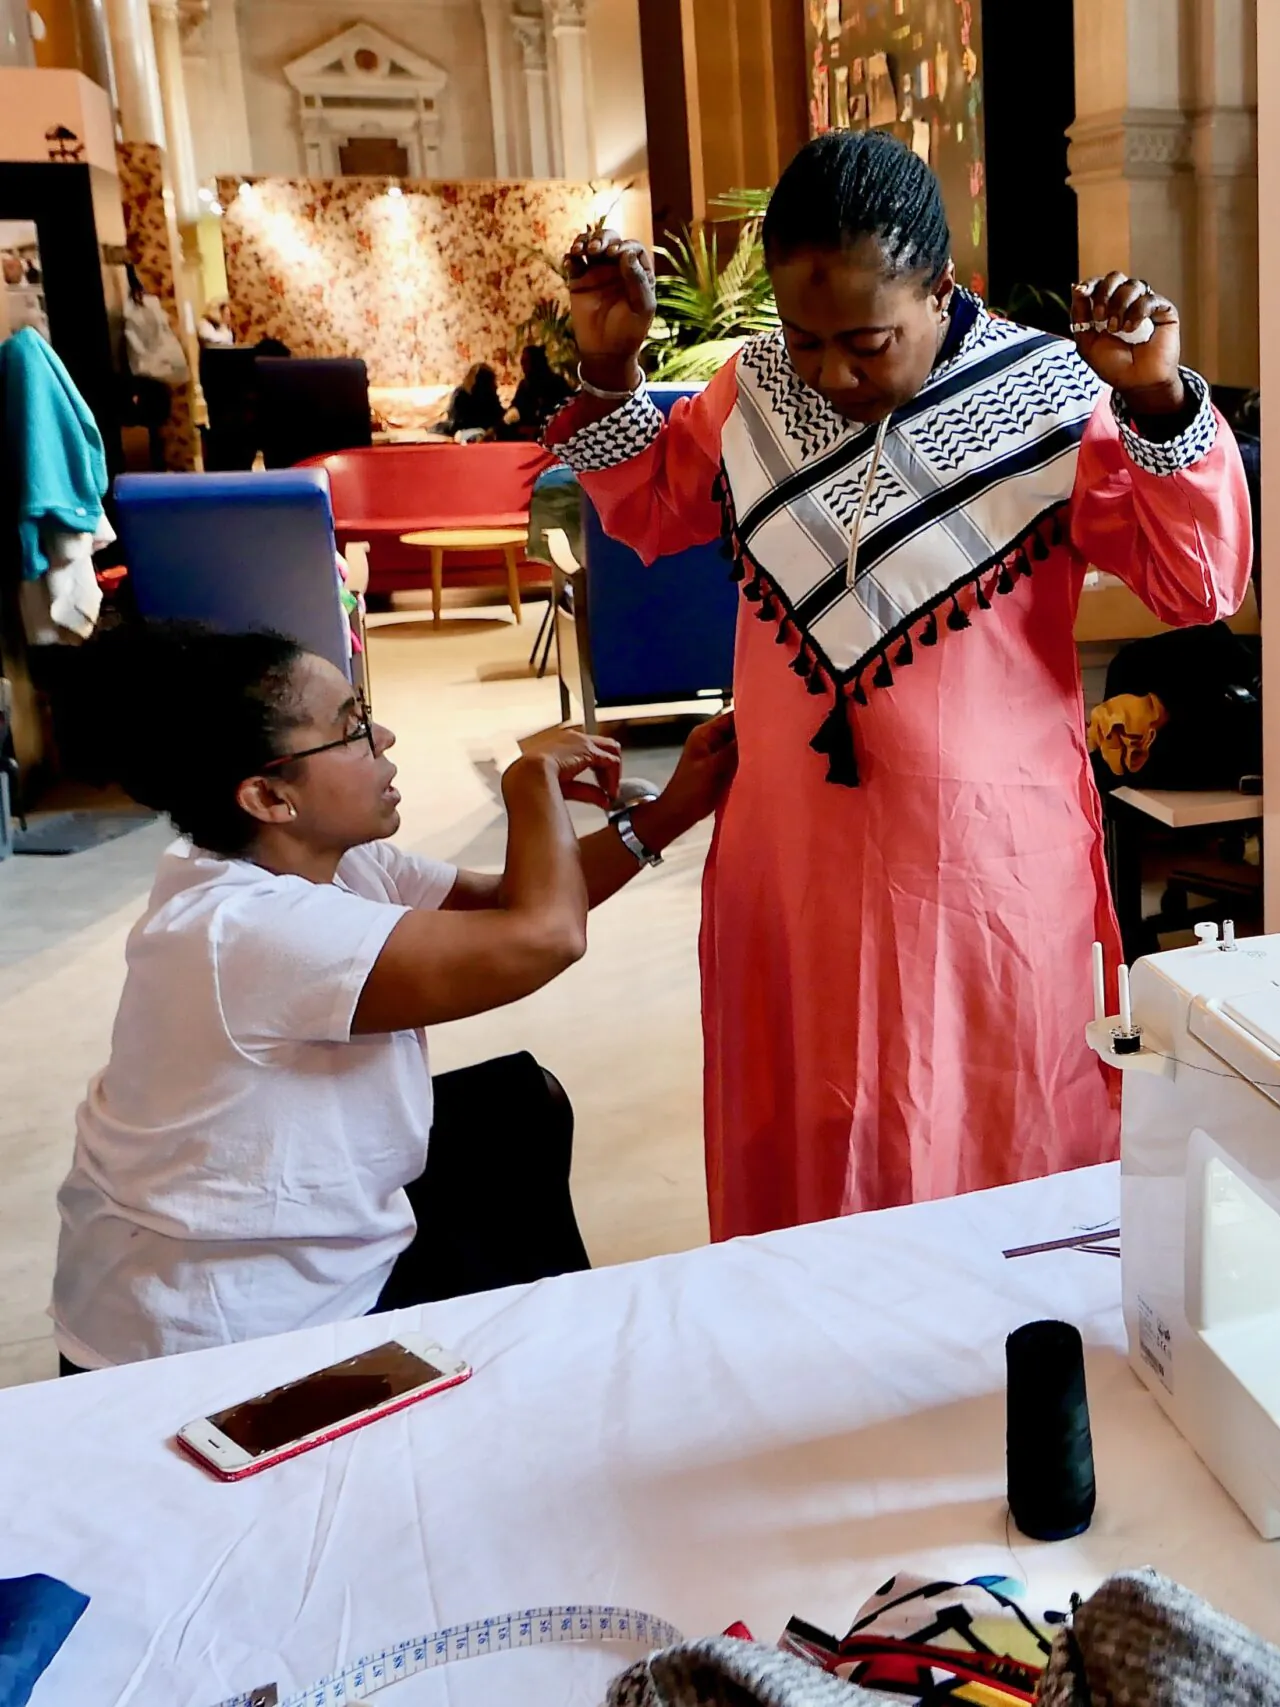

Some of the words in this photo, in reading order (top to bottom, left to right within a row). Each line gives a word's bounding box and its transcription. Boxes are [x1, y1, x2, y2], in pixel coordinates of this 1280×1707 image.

[373, 1665, 384, 1678] 87
[393, 1654, 405, 1669] 88
[435, 1641, 445, 1654] 90
[456, 1637, 467, 1649] 91
[478, 1631, 489, 1644] 92
